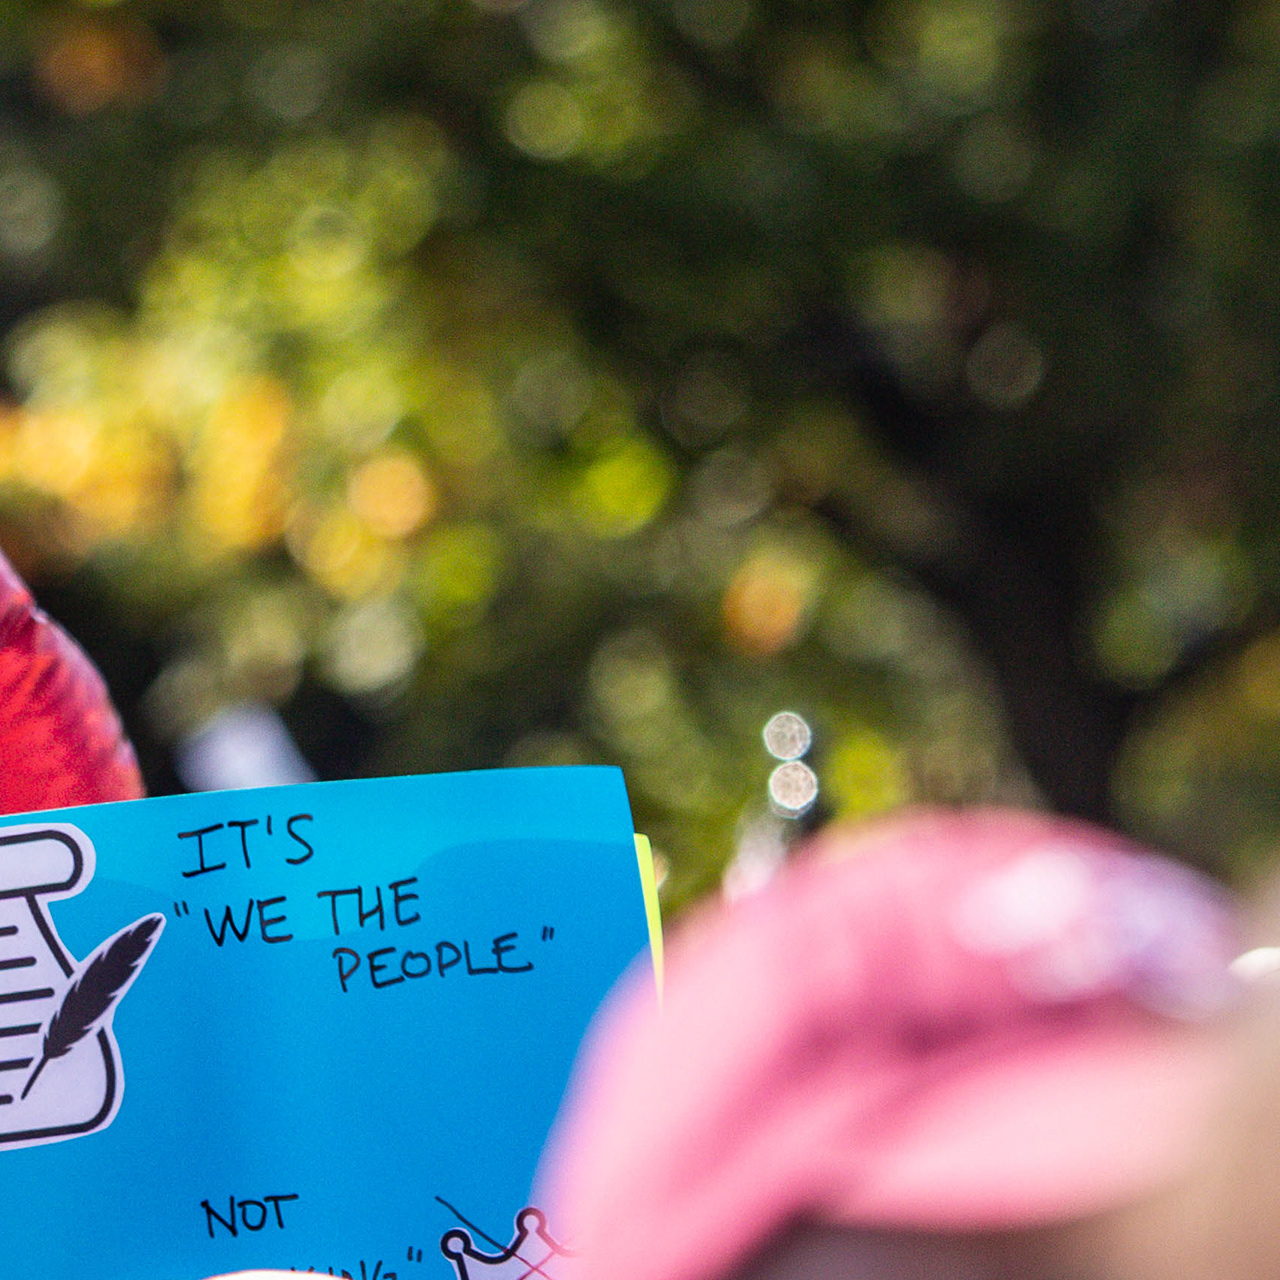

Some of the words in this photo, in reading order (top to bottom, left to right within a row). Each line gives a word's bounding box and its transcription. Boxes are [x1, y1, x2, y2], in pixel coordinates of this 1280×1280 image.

[178, 814, 314, 878] IT'S
[317, 876, 421, 935] THE
[333, 926, 555, 993] PEOPLE"
[200, 1193, 300, 1239] NOT
